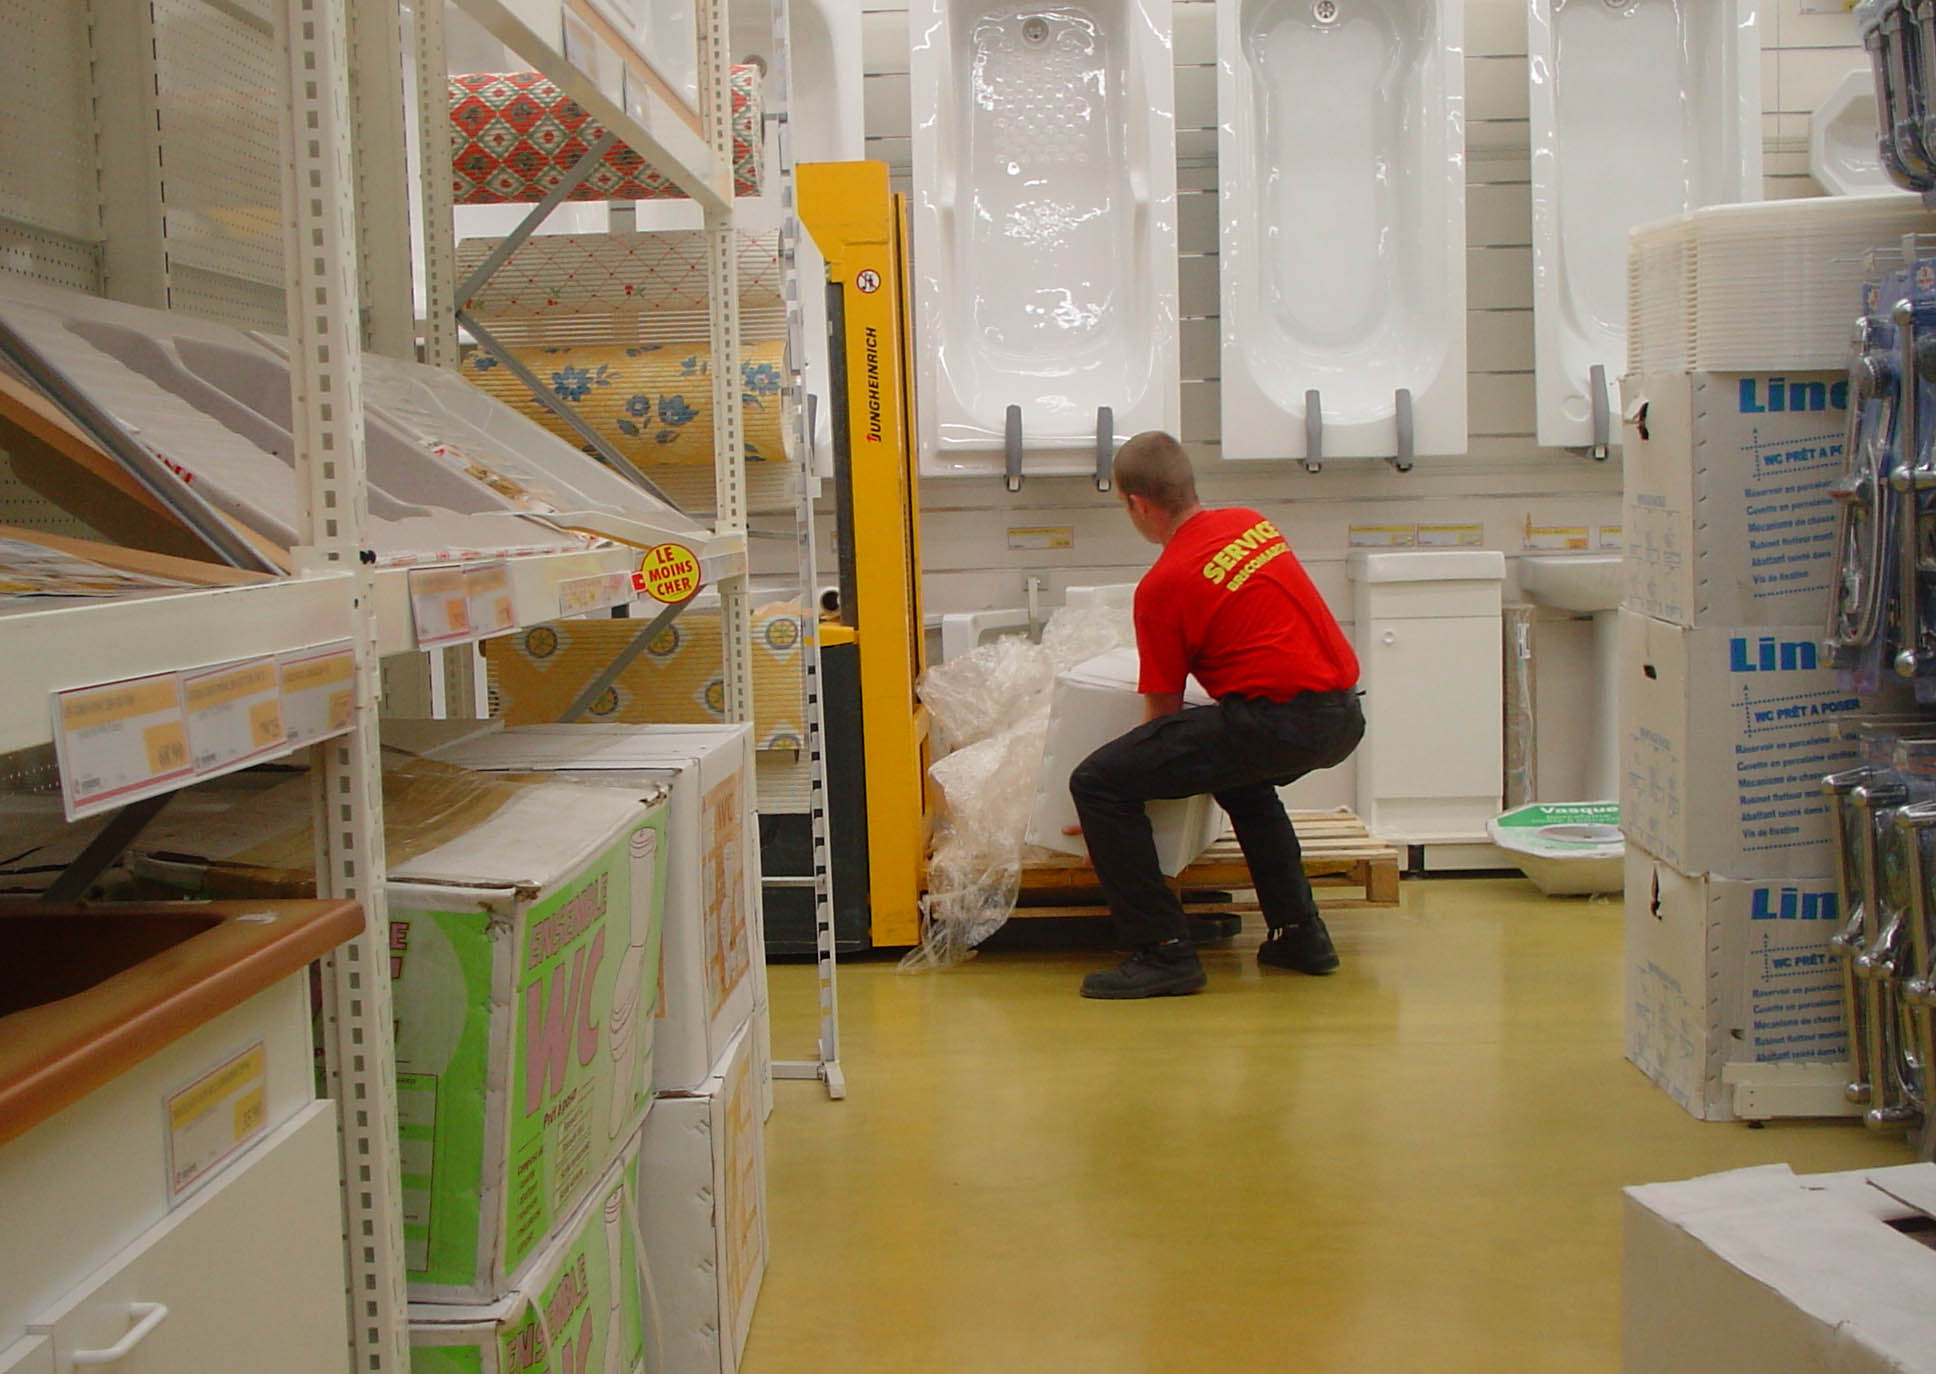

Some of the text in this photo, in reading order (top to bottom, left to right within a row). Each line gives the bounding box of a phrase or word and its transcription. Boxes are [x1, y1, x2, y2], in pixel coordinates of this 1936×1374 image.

[866, 327, 882, 443] JUNGHEINRICH
[648, 560, 693, 583] MOINS
[656, 546, 675, 565] LE
[656, 576, 692, 596] CHER
[1729, 636, 1817, 673] Lin
[528, 871, 609, 970] ENSEMBLE
[1751, 887, 1840, 921] Lin
[526, 924, 606, 1119] WC
